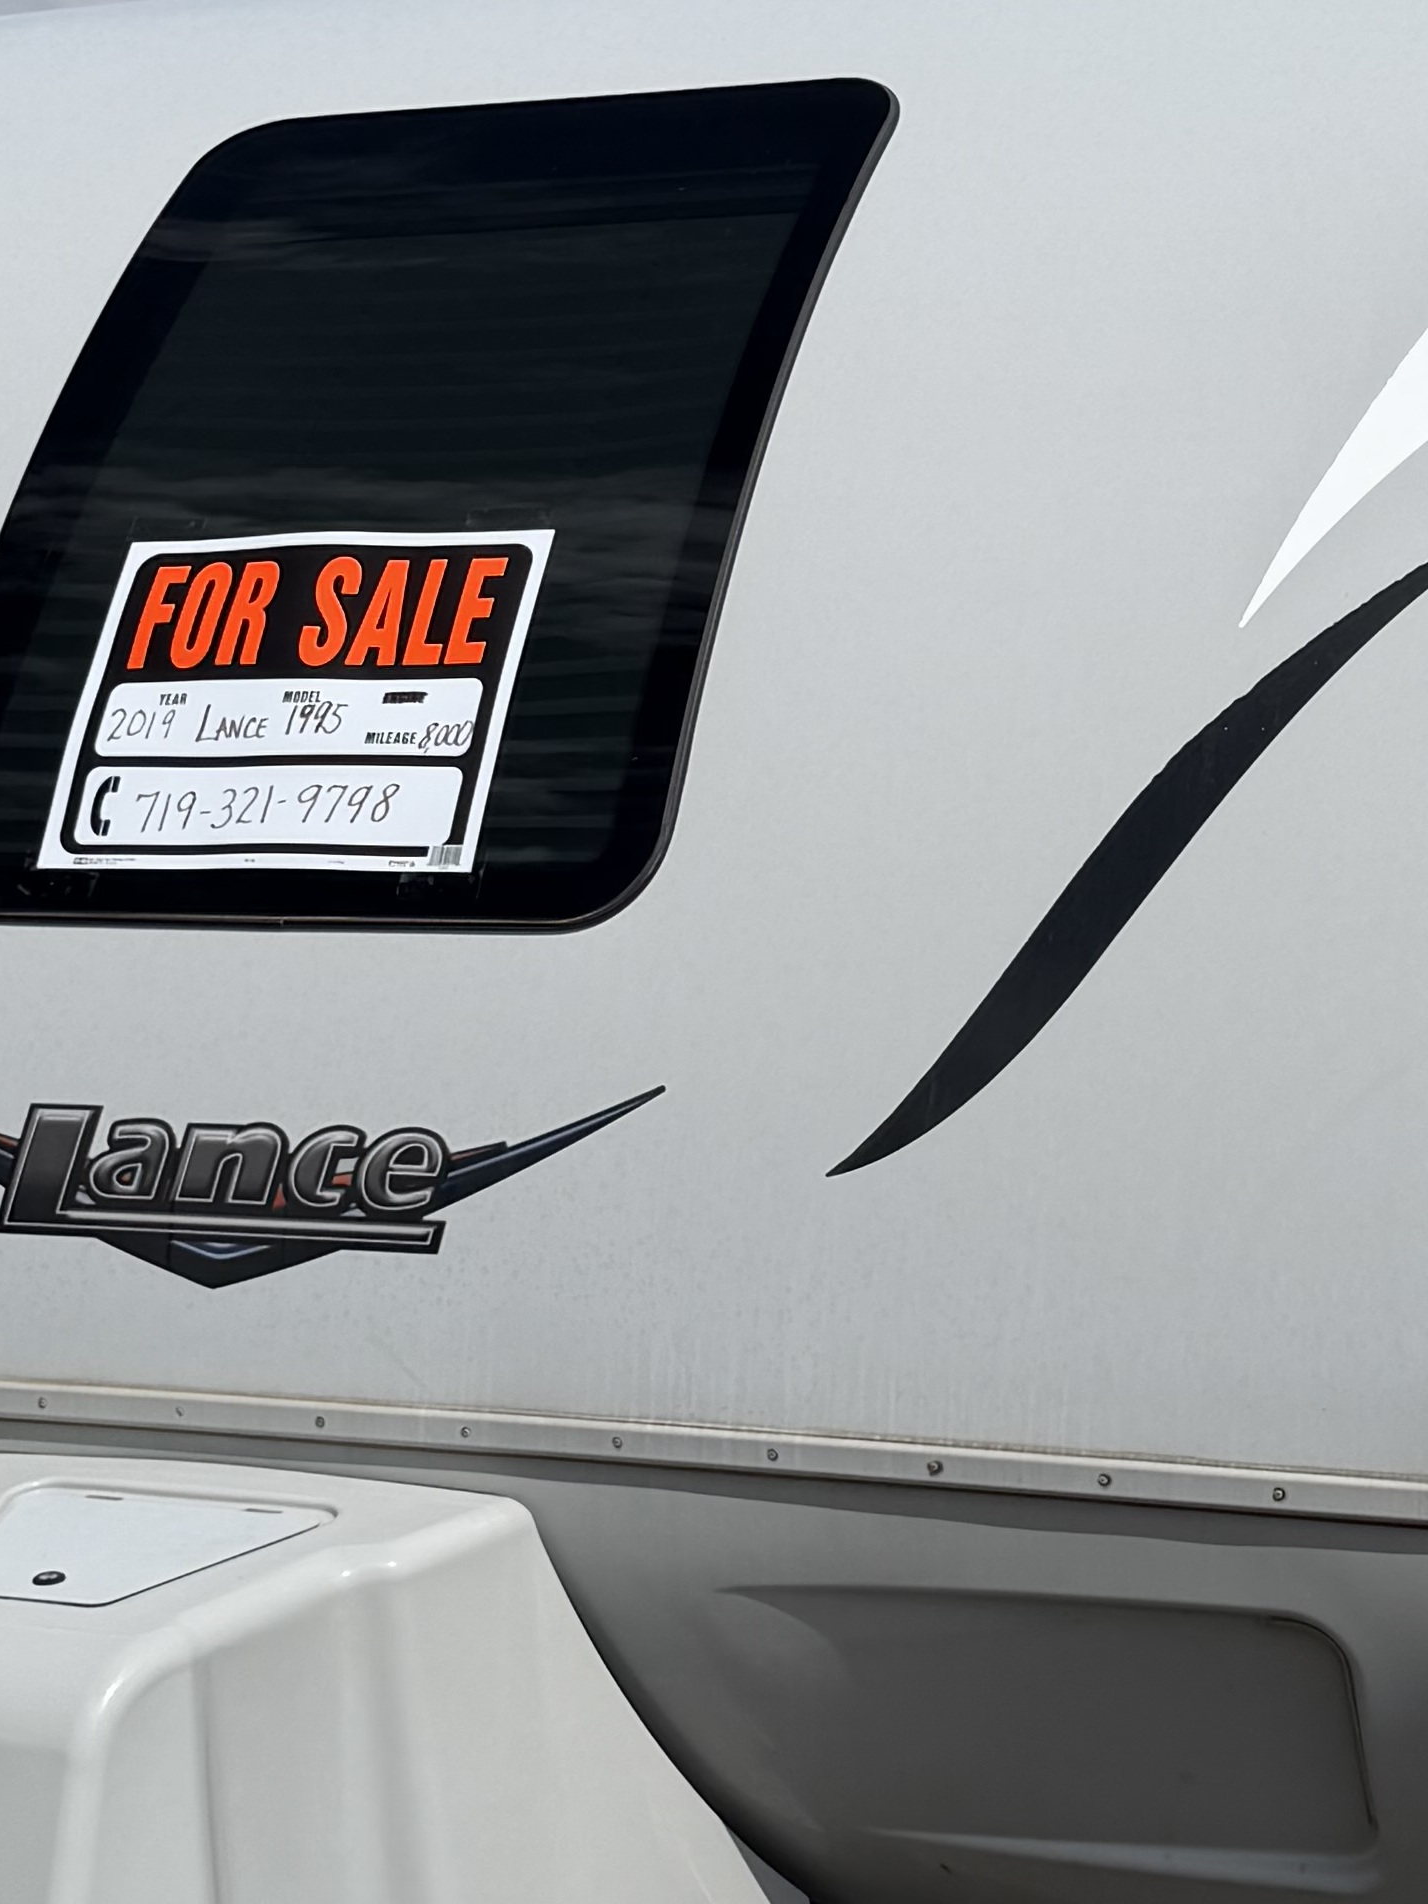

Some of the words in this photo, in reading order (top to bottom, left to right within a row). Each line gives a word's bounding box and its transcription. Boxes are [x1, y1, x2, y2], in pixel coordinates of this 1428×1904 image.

[126, 561, 280, 670] FOR
[298, 556, 509, 667] SALE
[159, 693, 188, 706] YEAR
[282, 691, 322, 703] MODEL
[107, 708, 176, 742] 2019
[195, 704, 270, 742] LANCE
[364, 731, 418, 745] MILEAGE
[418, 720, 474, 753] 8,000
[136, 783, 400, 833] 719-321-9798
